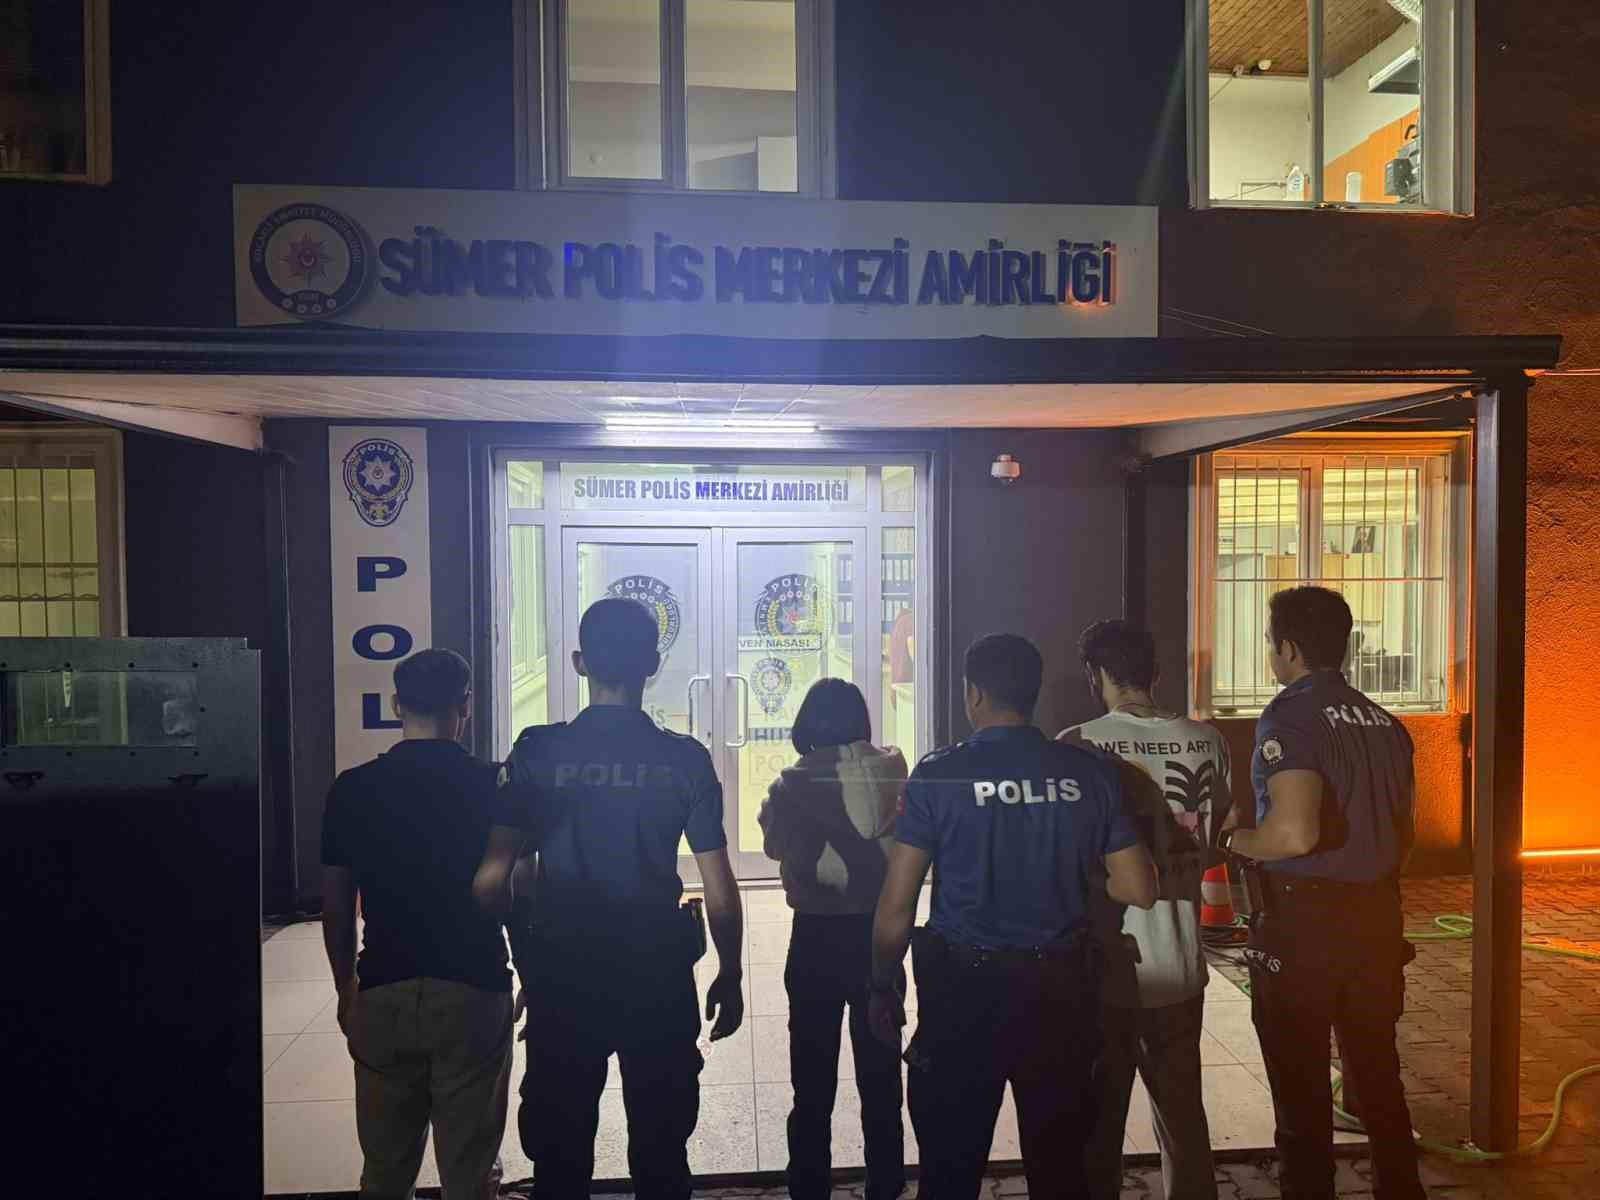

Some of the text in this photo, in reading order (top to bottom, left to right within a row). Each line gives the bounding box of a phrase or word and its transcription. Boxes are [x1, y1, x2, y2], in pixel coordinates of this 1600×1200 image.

[378, 225, 556, 299] SÜMER
[564, 231, 704, 303] POLİS
[714, 237, 910, 305] MERKEZİ
[916, 236, 1116, 306] AMİRLİĞİ
[574, 476, 849, 501] SÜMER POLİS MERKEZİ AMİRLİĞİ
[1099, 740, 1212, 755] WE NEED ART
